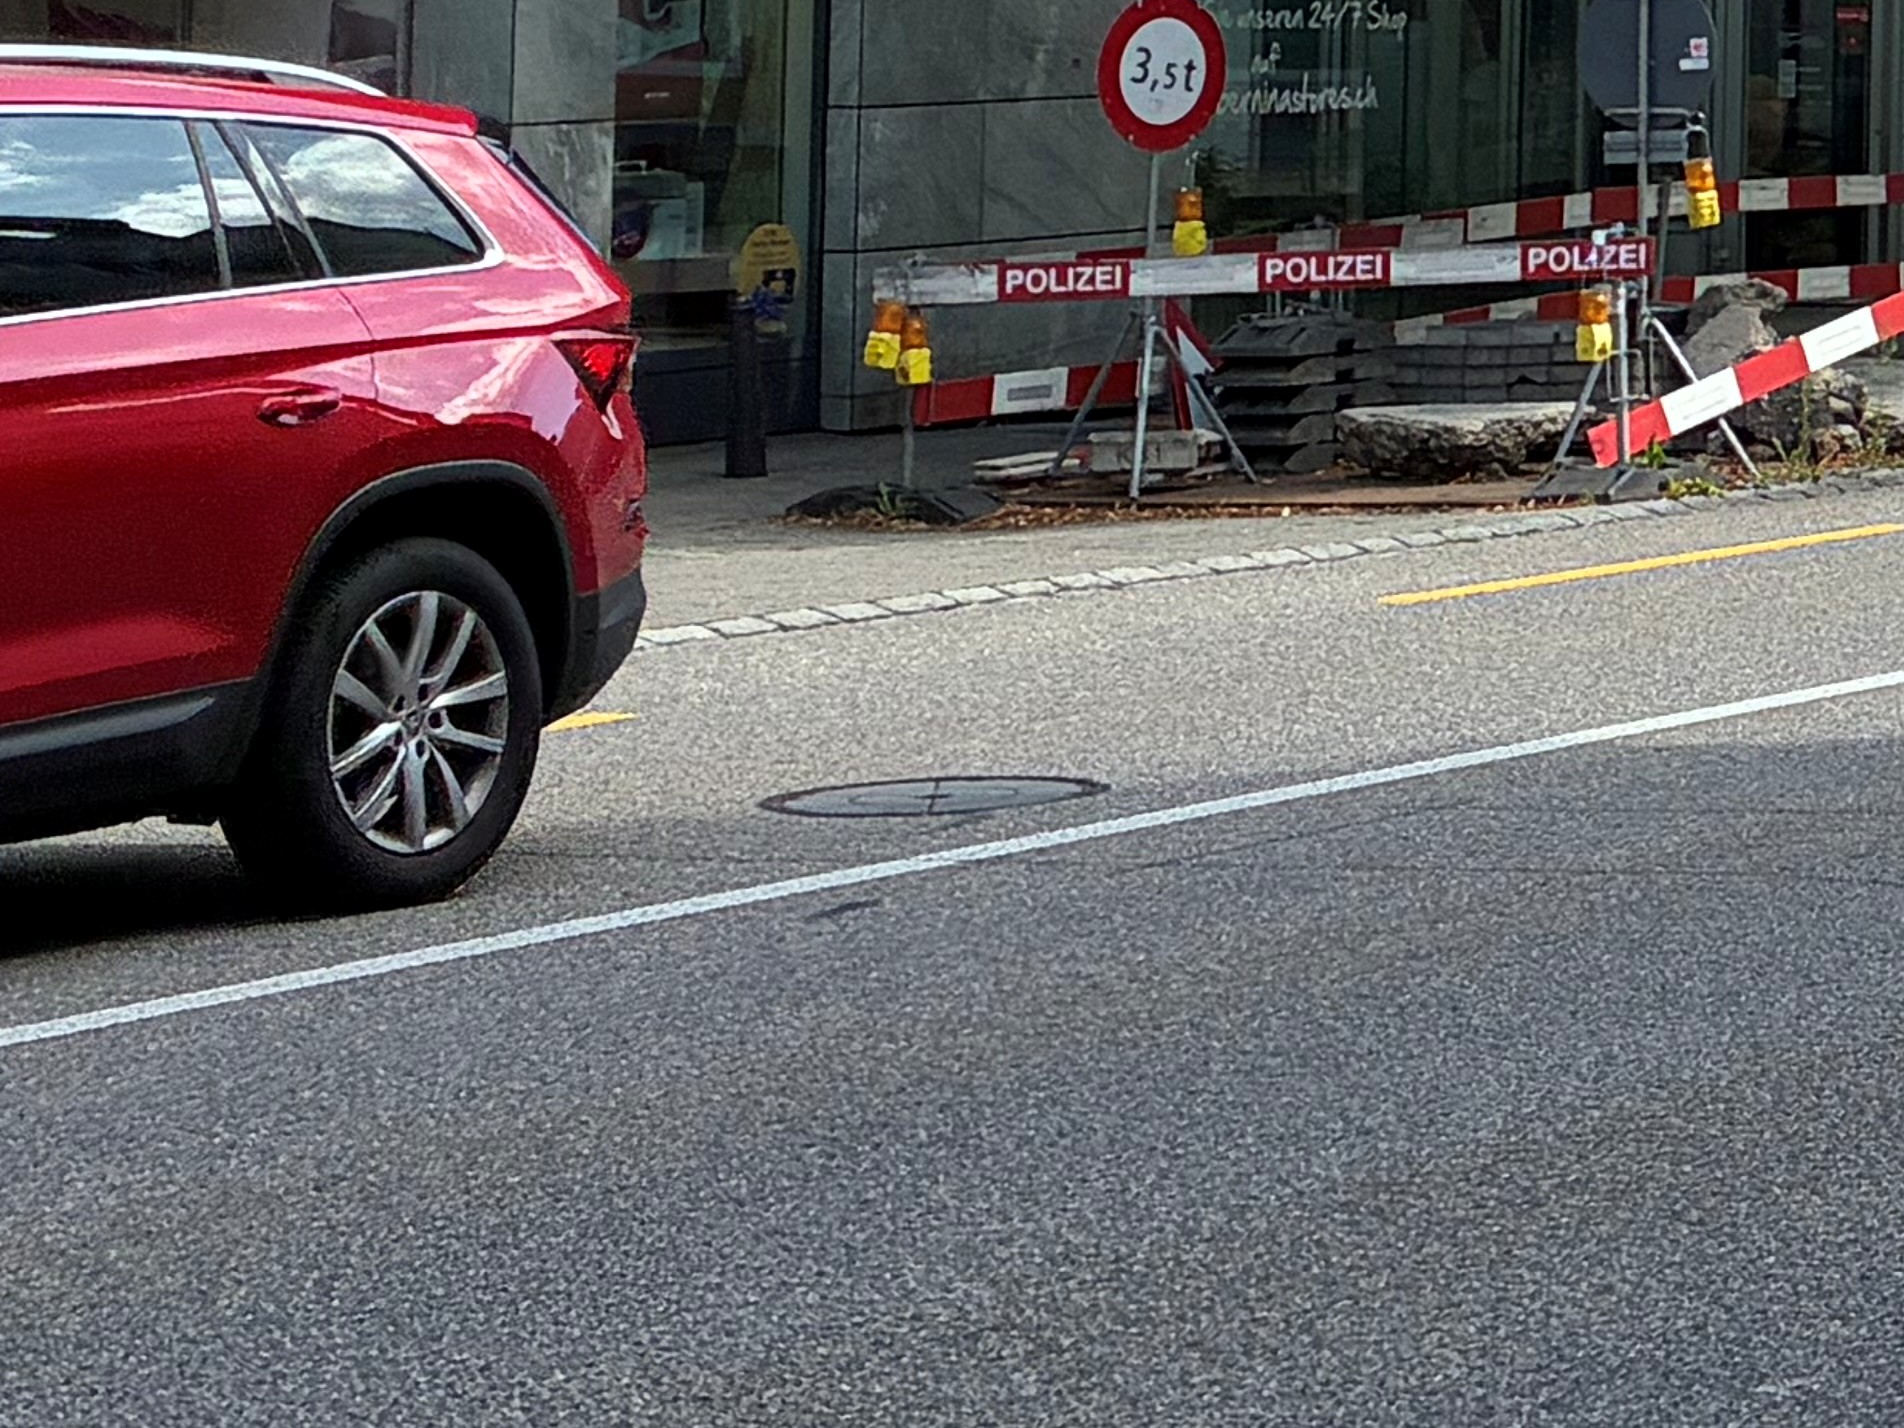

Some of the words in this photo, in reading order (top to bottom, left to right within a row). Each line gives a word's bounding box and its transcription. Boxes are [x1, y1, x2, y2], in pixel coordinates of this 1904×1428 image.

[1265, 254, 1383, 284] POLIZEI
[1527, 243, 1647, 274] POLIZEI
[1005, 265, 1122, 294] POLIZEI
